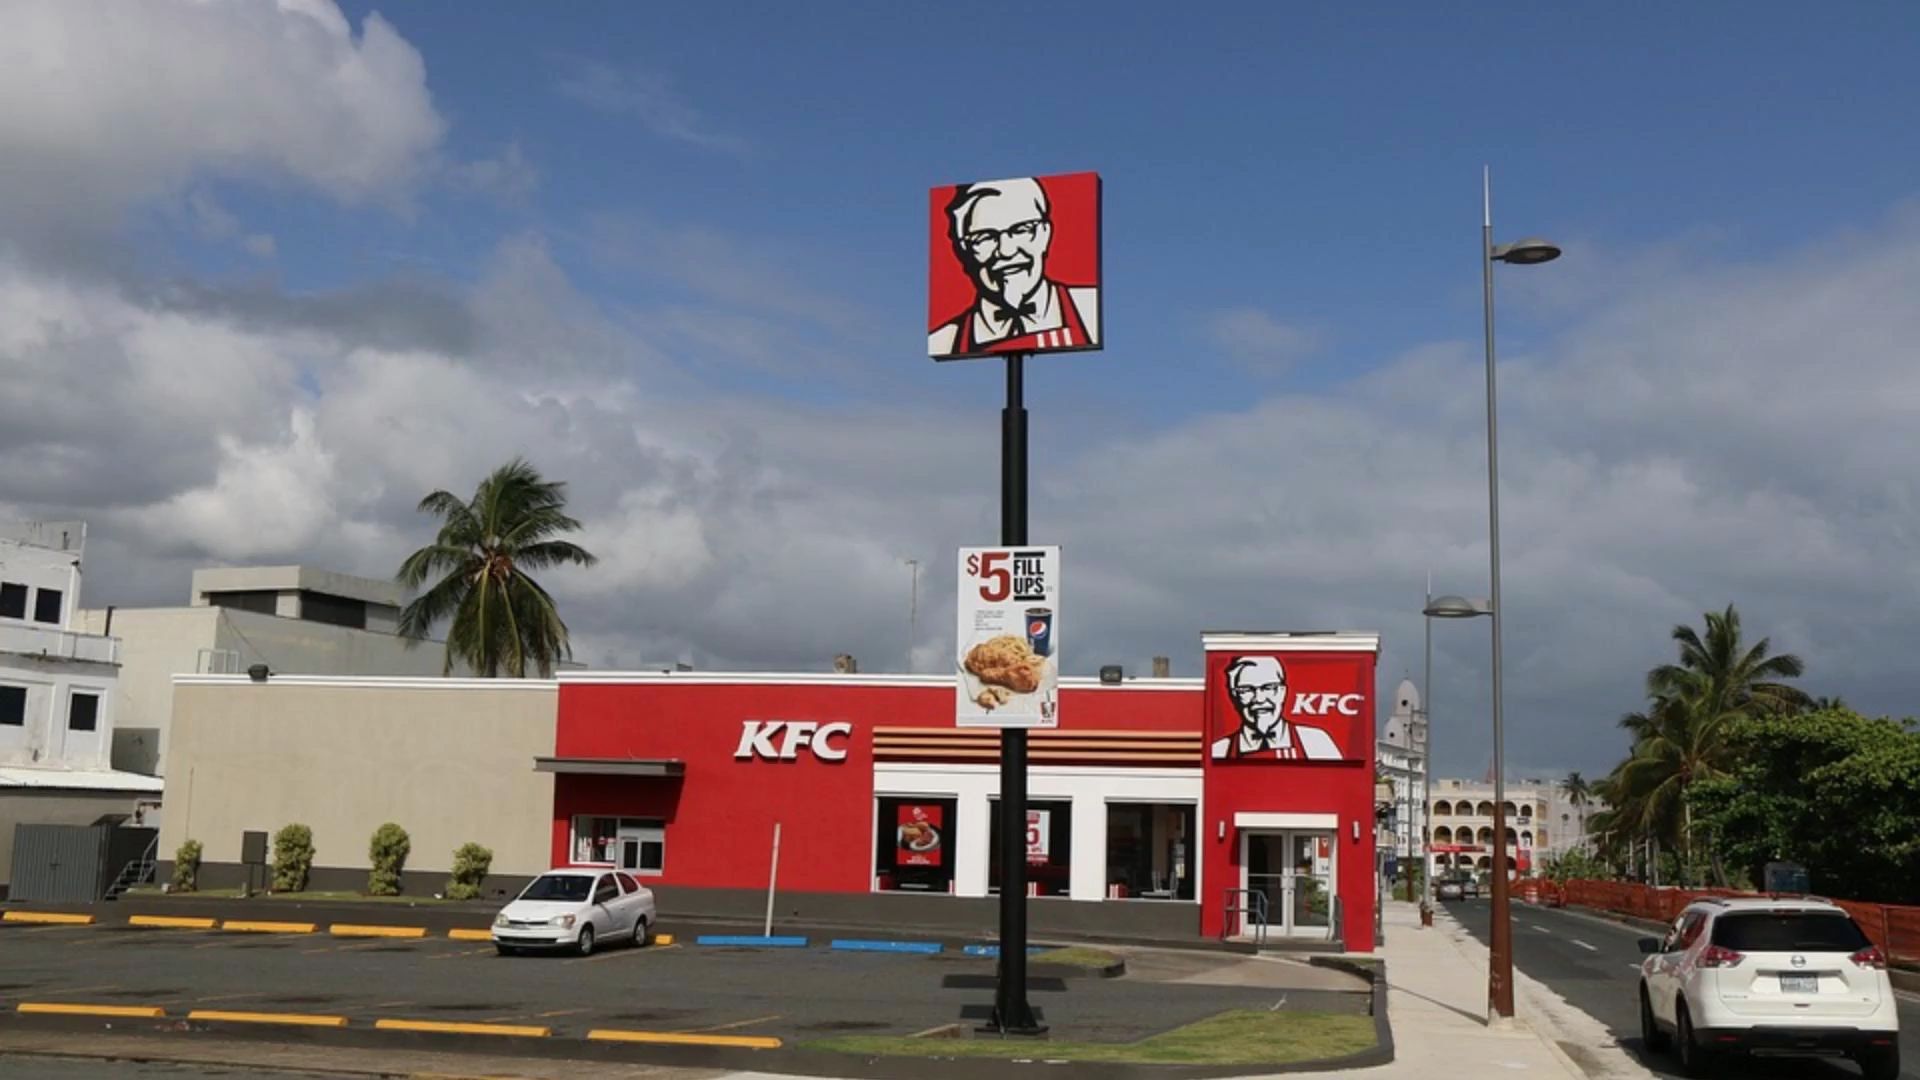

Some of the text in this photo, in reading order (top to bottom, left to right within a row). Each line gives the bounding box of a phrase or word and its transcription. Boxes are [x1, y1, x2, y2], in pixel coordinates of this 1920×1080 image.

[966, 552, 1011, 602] $5
[1013, 559, 1045, 576] FILL
[1013, 577, 1044, 594] UPS
[1291, 693, 1364, 715] KFC
[734, 720, 852, 760] KFC
